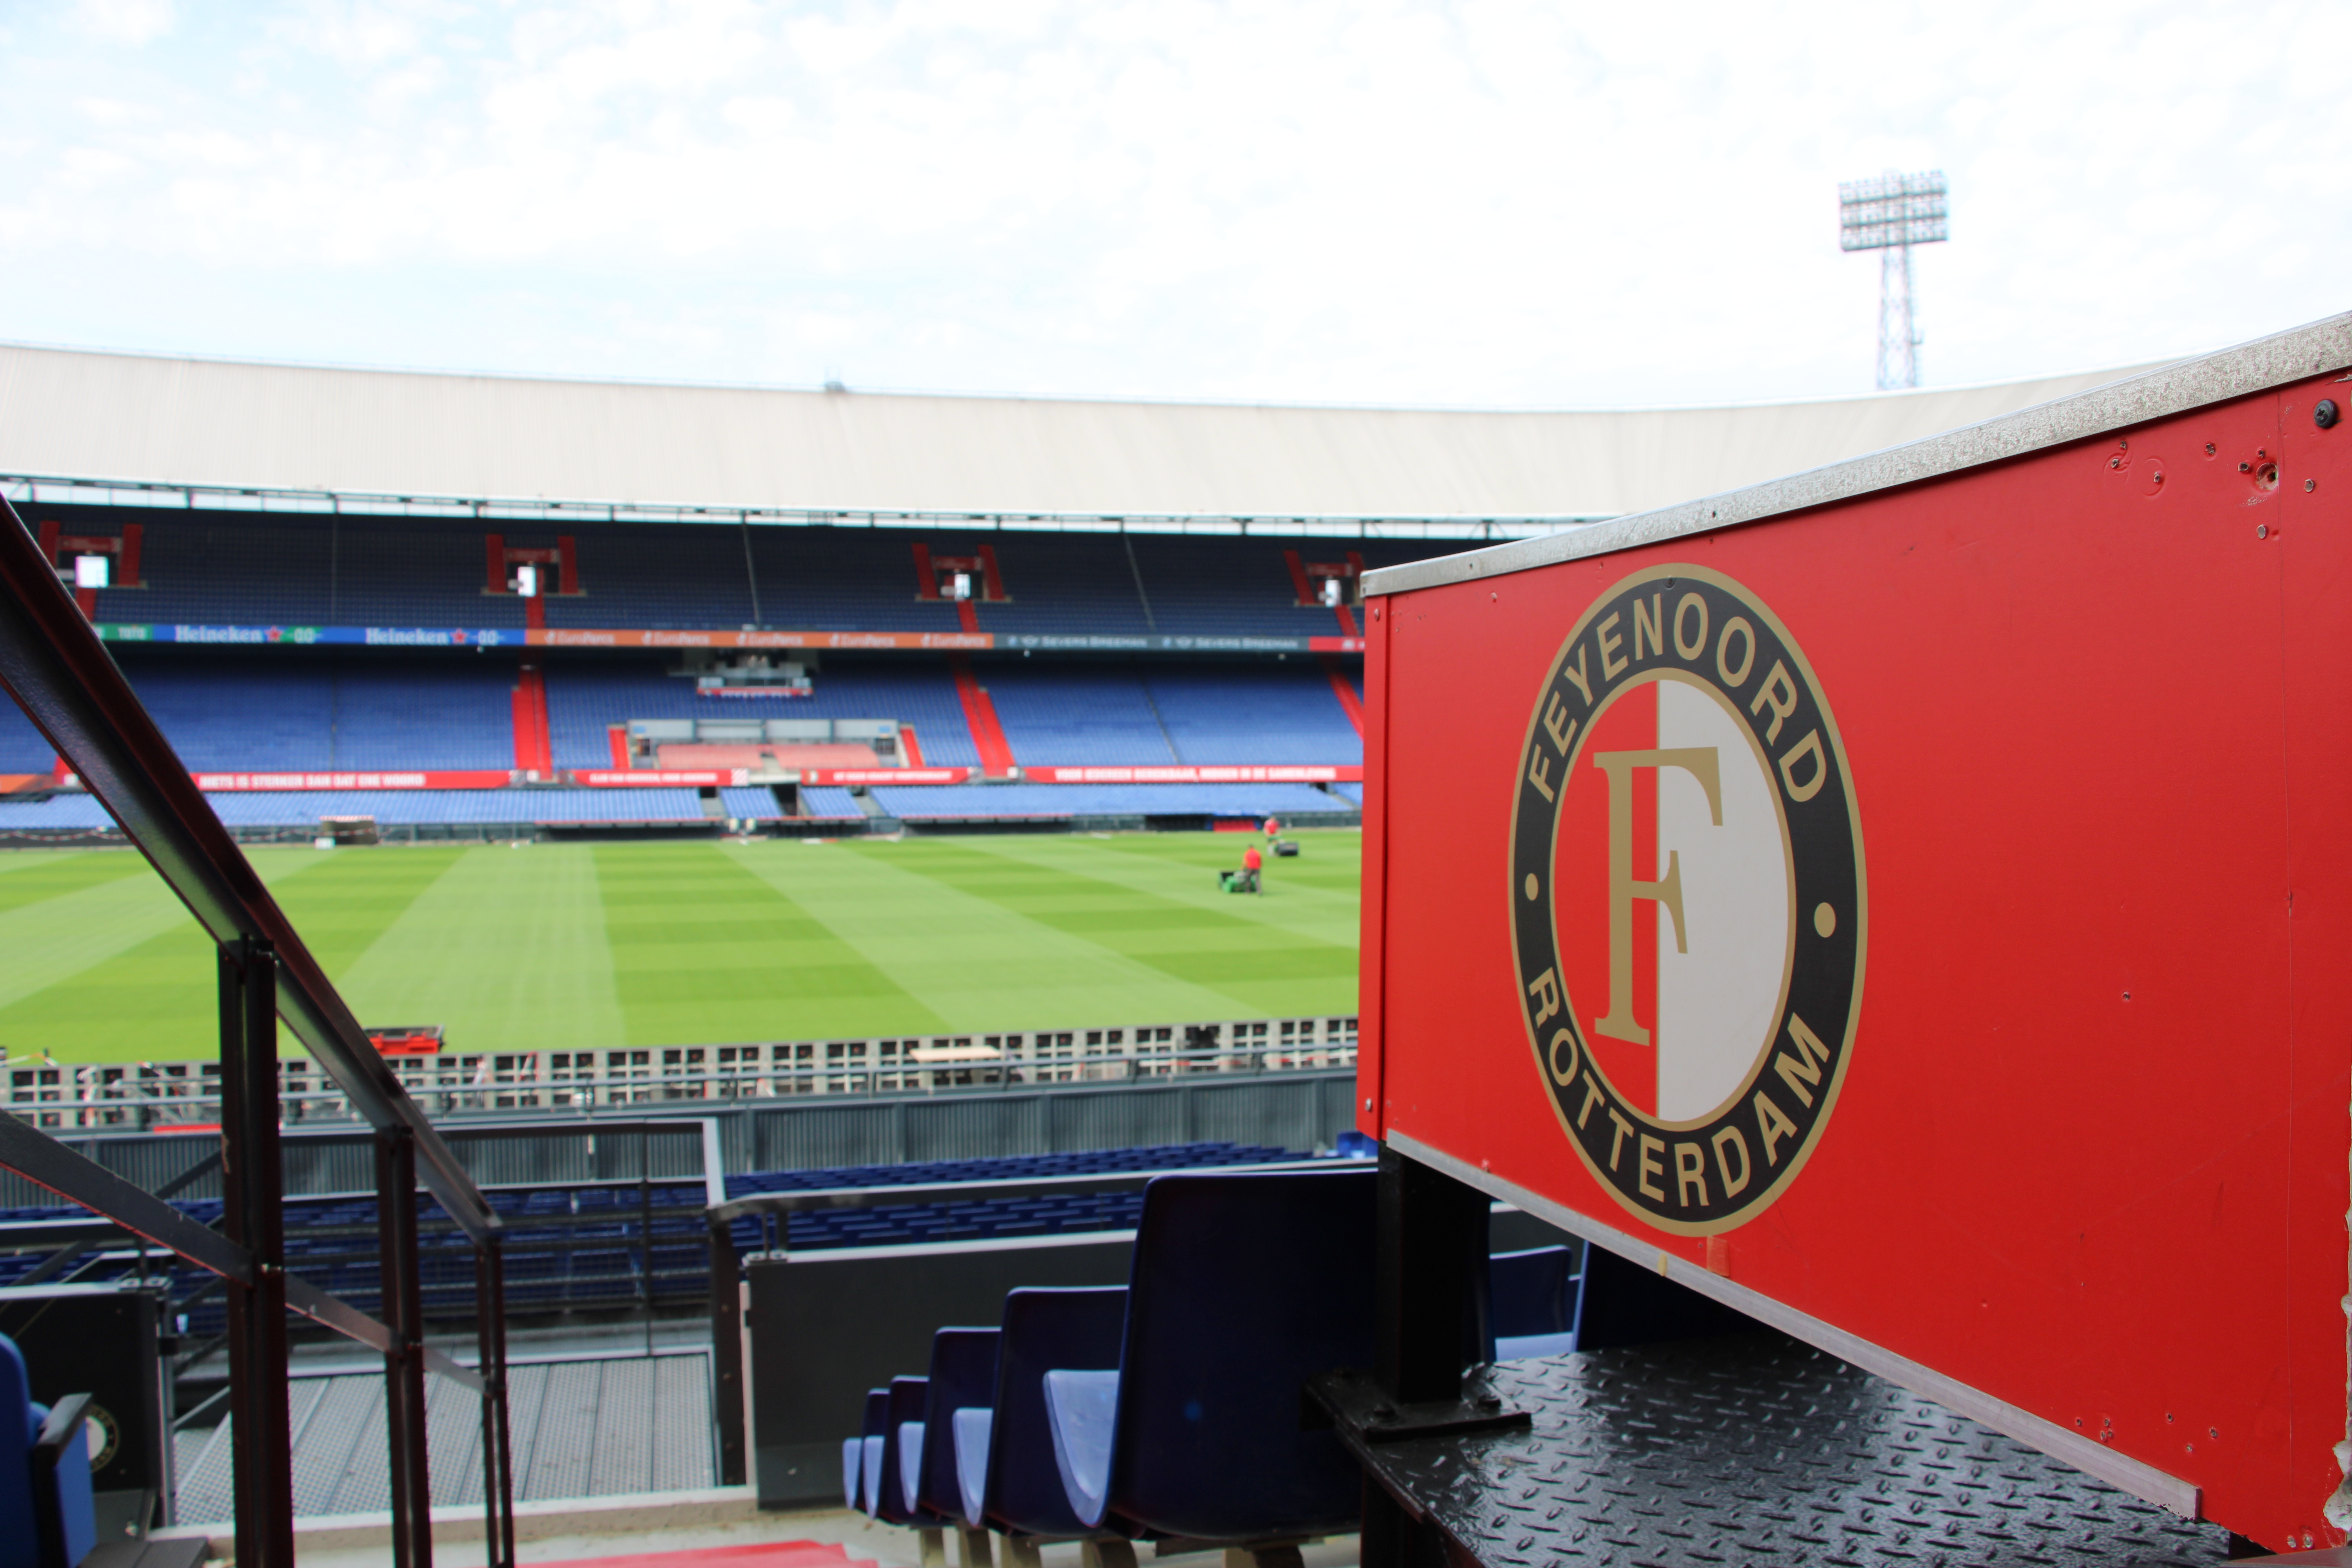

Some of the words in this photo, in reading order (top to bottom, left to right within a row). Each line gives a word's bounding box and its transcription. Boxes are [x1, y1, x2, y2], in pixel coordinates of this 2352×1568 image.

[175, 625, 263, 642] Heineken
[366, 628, 449, 645] Heineken
[1528, 592, 1827, 803] FEYENOORD
[199, 774, 234, 789] NIETS
[236, 774, 249, 789] IS
[250, 774, 304, 789] STERKER
[306, 773, 331, 788] DAN
[333, 773, 356, 788] DAT
[357, 773, 381, 788] ENE
[382, 773, 426, 788] WOORD
[1593, 747, 1723, 1046] F
[1528, 967, 1830, 1207] ROTTERDAM
